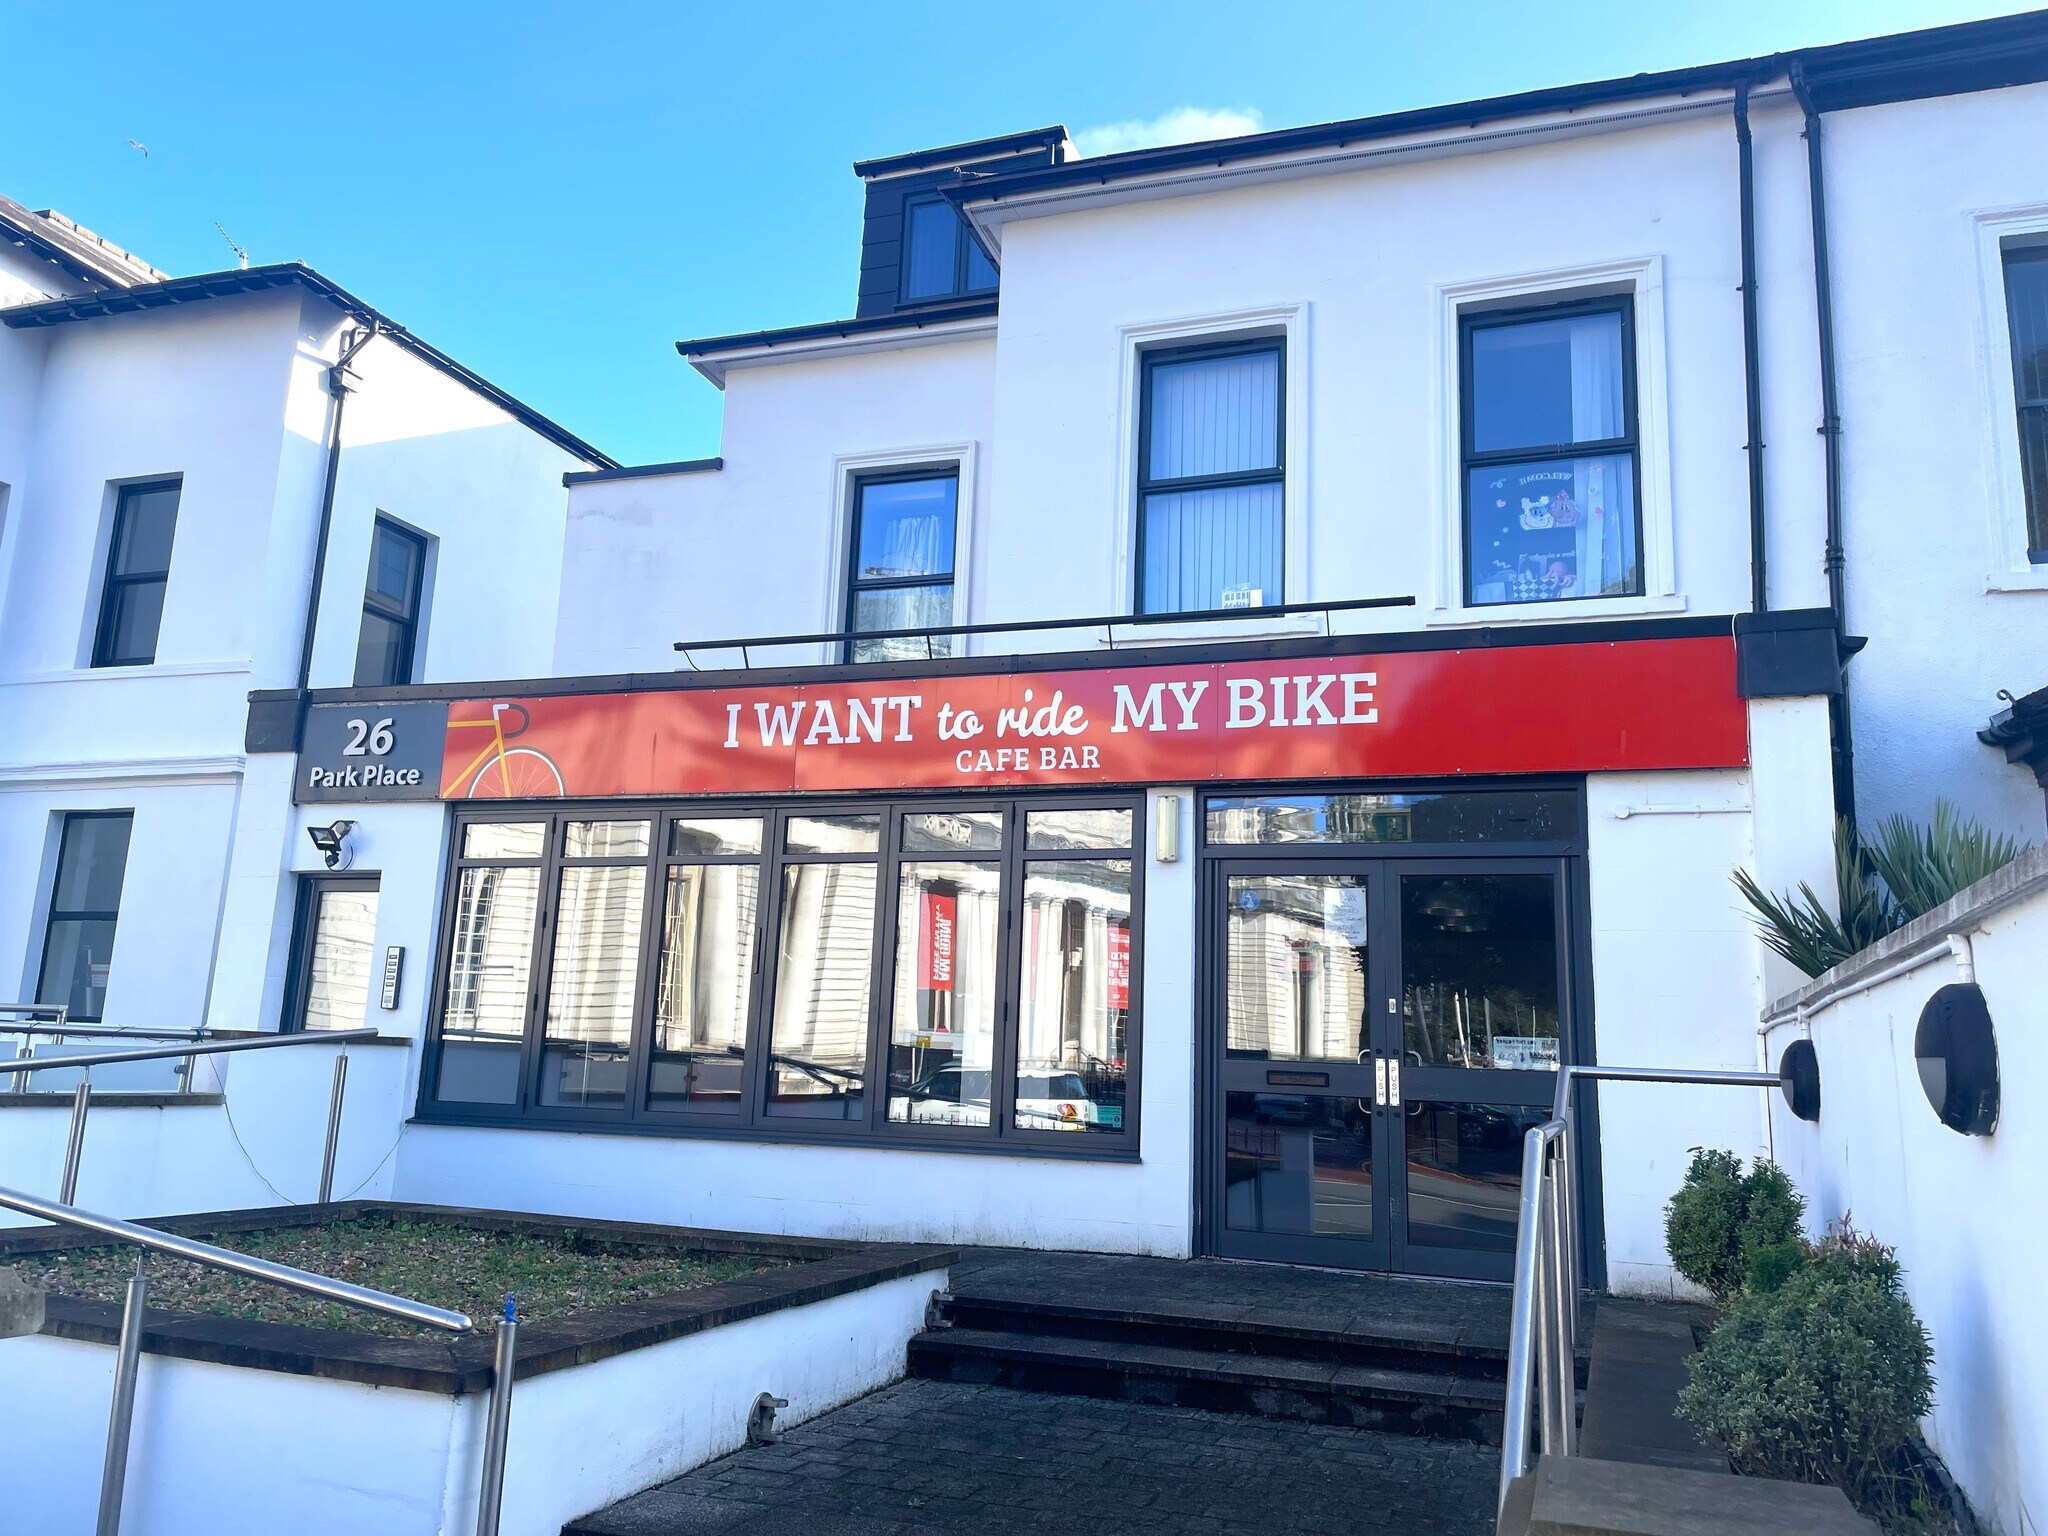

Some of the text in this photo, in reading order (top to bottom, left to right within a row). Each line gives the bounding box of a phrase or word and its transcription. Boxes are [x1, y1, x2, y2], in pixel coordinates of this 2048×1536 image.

[723, 672, 1378, 748] I WANT to ride MY BIKE
[342, 717, 394, 757] 26
[309, 763, 420, 788] Park Place
[956, 745, 1101, 773] CAFE BAR
[1377, 1065, 1385, 1098] PUSH
[1390, 1066, 1398, 1099] PUSH
